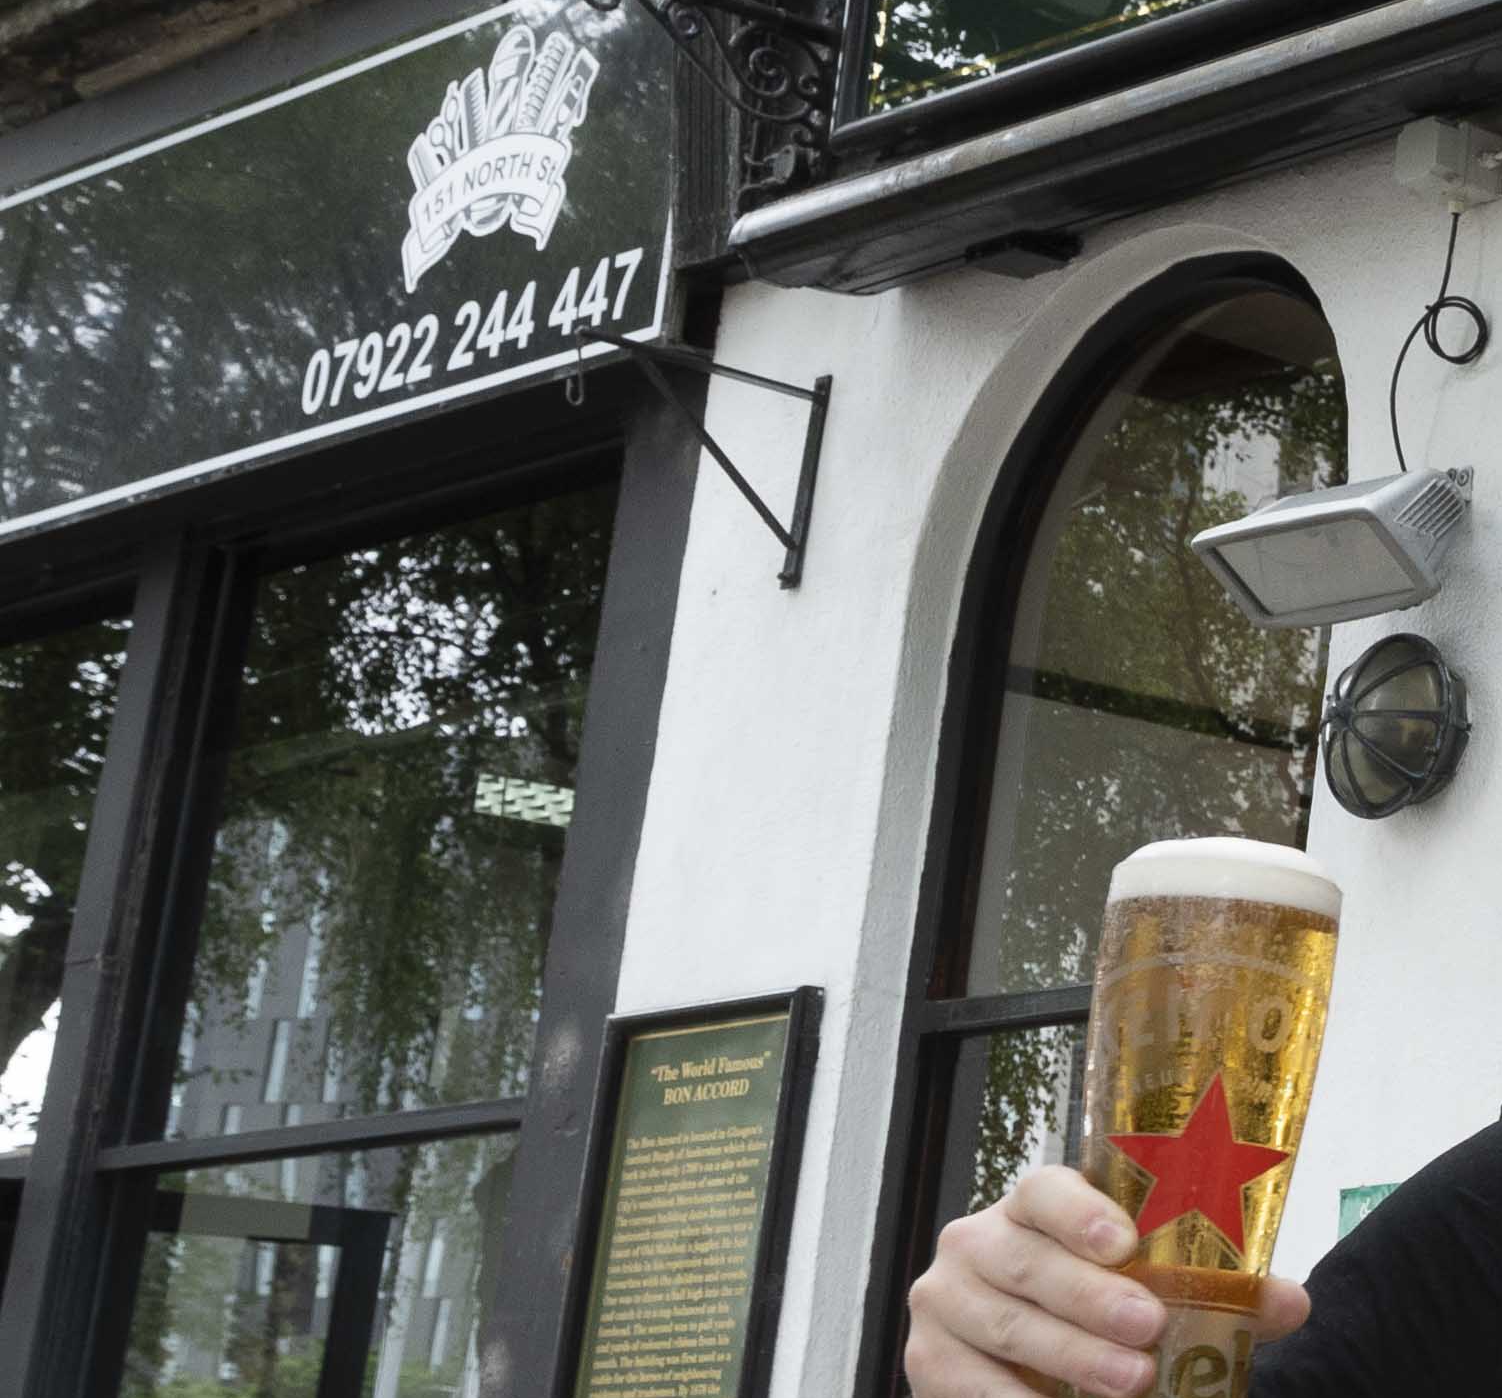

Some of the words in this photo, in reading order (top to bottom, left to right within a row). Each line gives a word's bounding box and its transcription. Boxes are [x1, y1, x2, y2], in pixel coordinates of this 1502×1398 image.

[423, 181, 453, 223] 151
[462, 152, 534, 196] NORTH
[301, 313, 440, 415] 07922
[446, 280, 537, 372] 244
[547, 246, 644, 336] 447
[664, 1085, 691, 1106] BON
[692, 1078, 749, 1101] ACCORD
